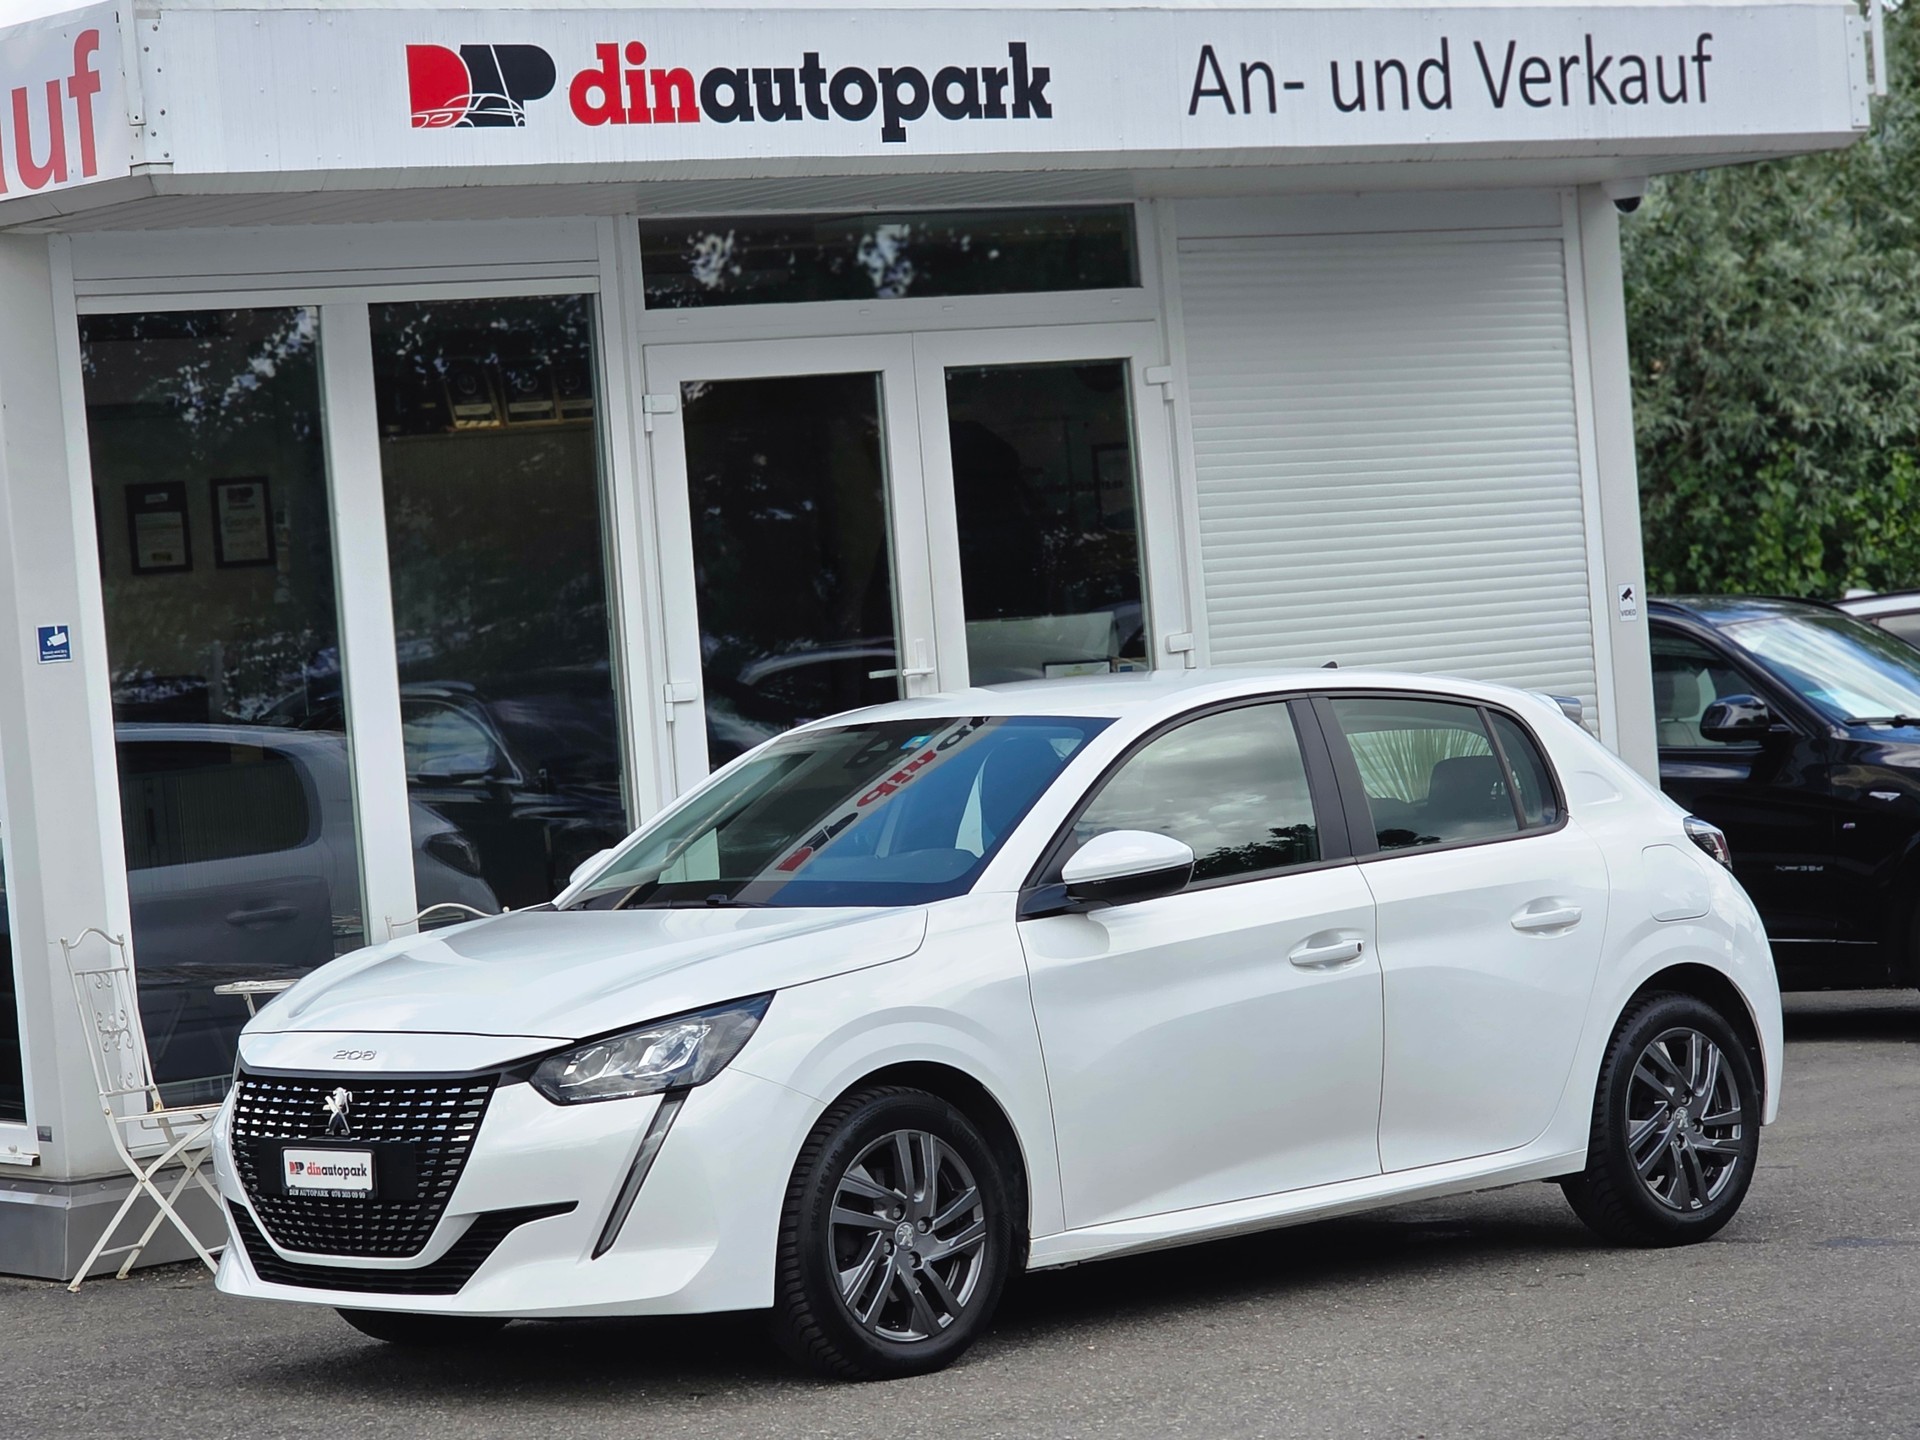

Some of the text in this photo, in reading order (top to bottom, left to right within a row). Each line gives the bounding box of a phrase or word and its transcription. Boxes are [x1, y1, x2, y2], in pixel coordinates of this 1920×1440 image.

[0, 28, 101, 194] uf
[569, 41, 1053, 142] dinautopark
[1188, 32, 1713, 115] An- und Verkauf
[333, 1050, 377, 1061] 208
[307, 1162, 367, 1179] dinautopark
